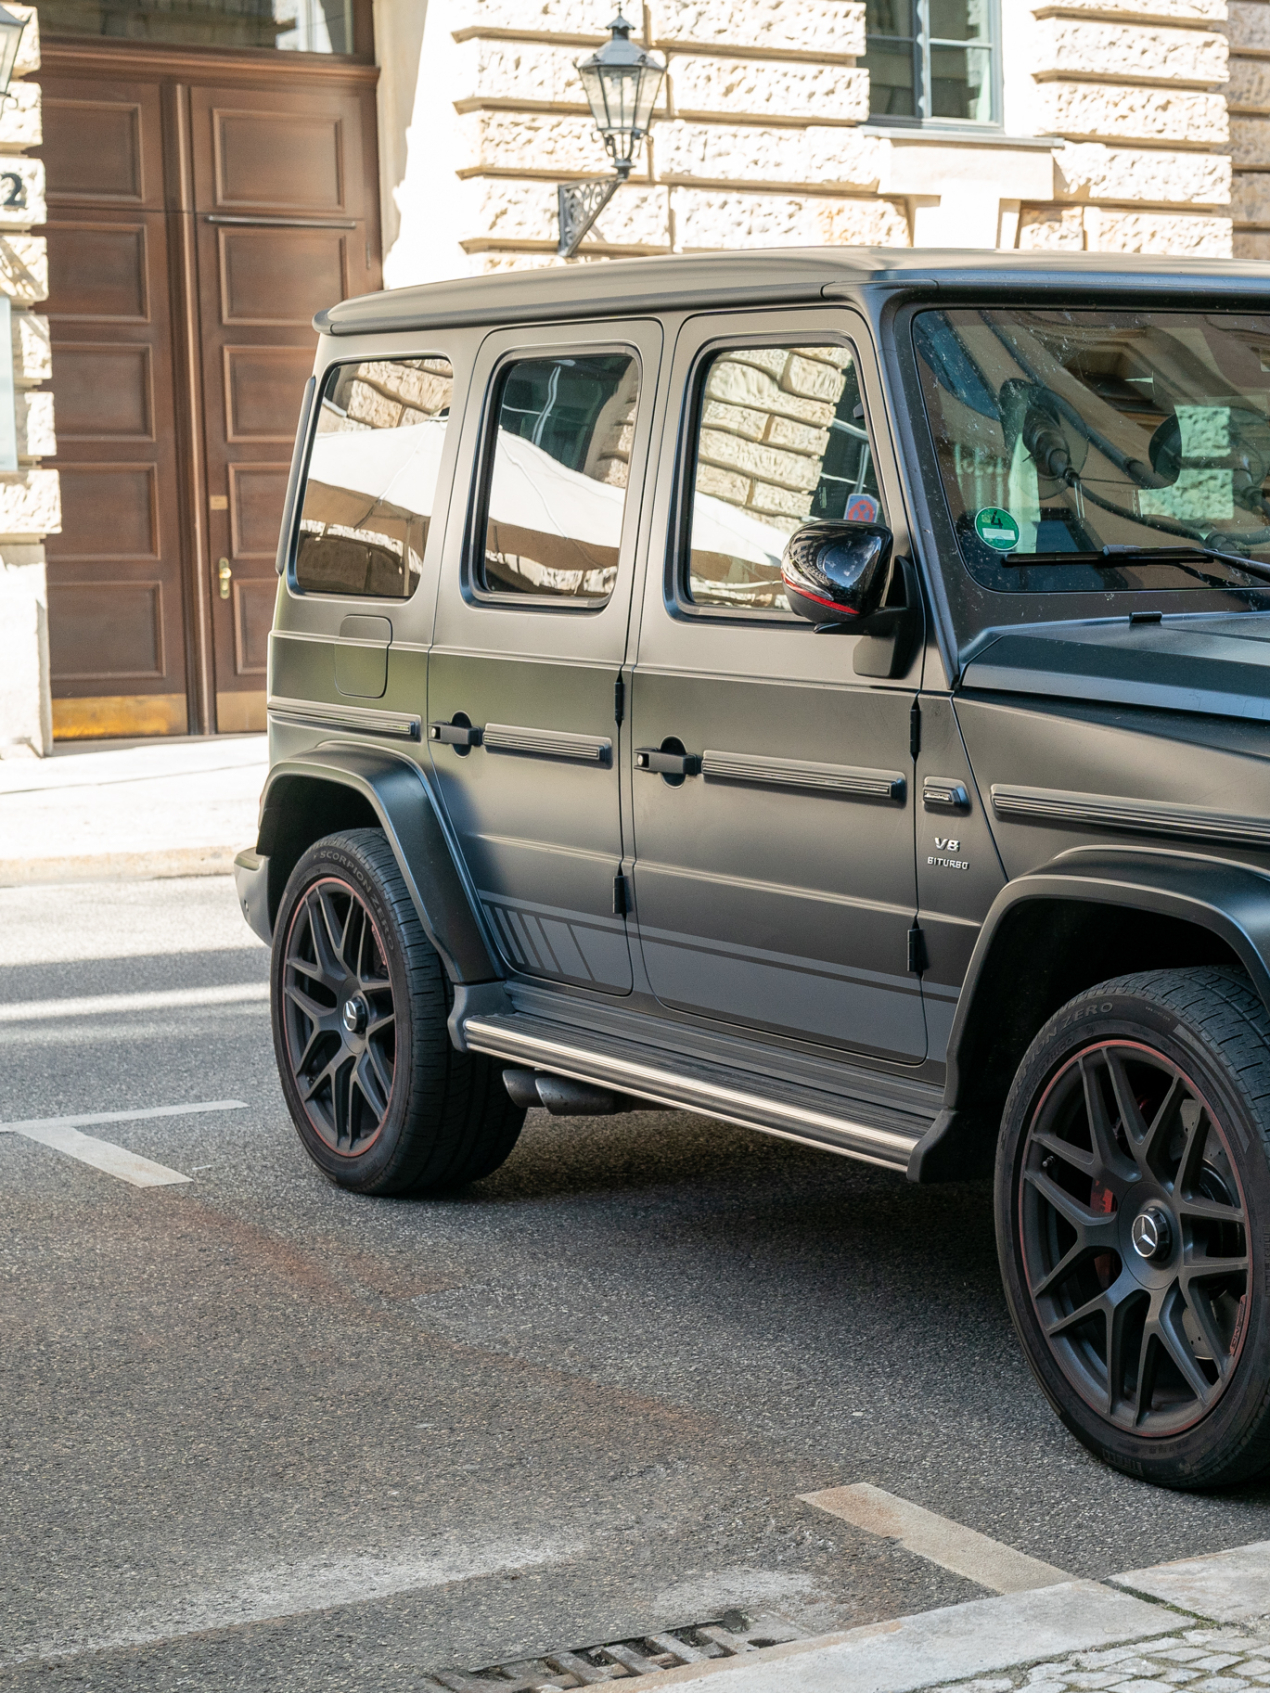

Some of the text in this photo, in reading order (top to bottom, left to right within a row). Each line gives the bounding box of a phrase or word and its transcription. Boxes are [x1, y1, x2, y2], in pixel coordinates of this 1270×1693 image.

[990, 509, 1004, 529] 4
[934, 837, 961, 852] V8
[927, 856, 970, 870] BITURBO
[320, 850, 372, 893] SCORPION
[371, 894, 394, 950] ZERO
[1061, 1002, 1113, 1026] ZERO
